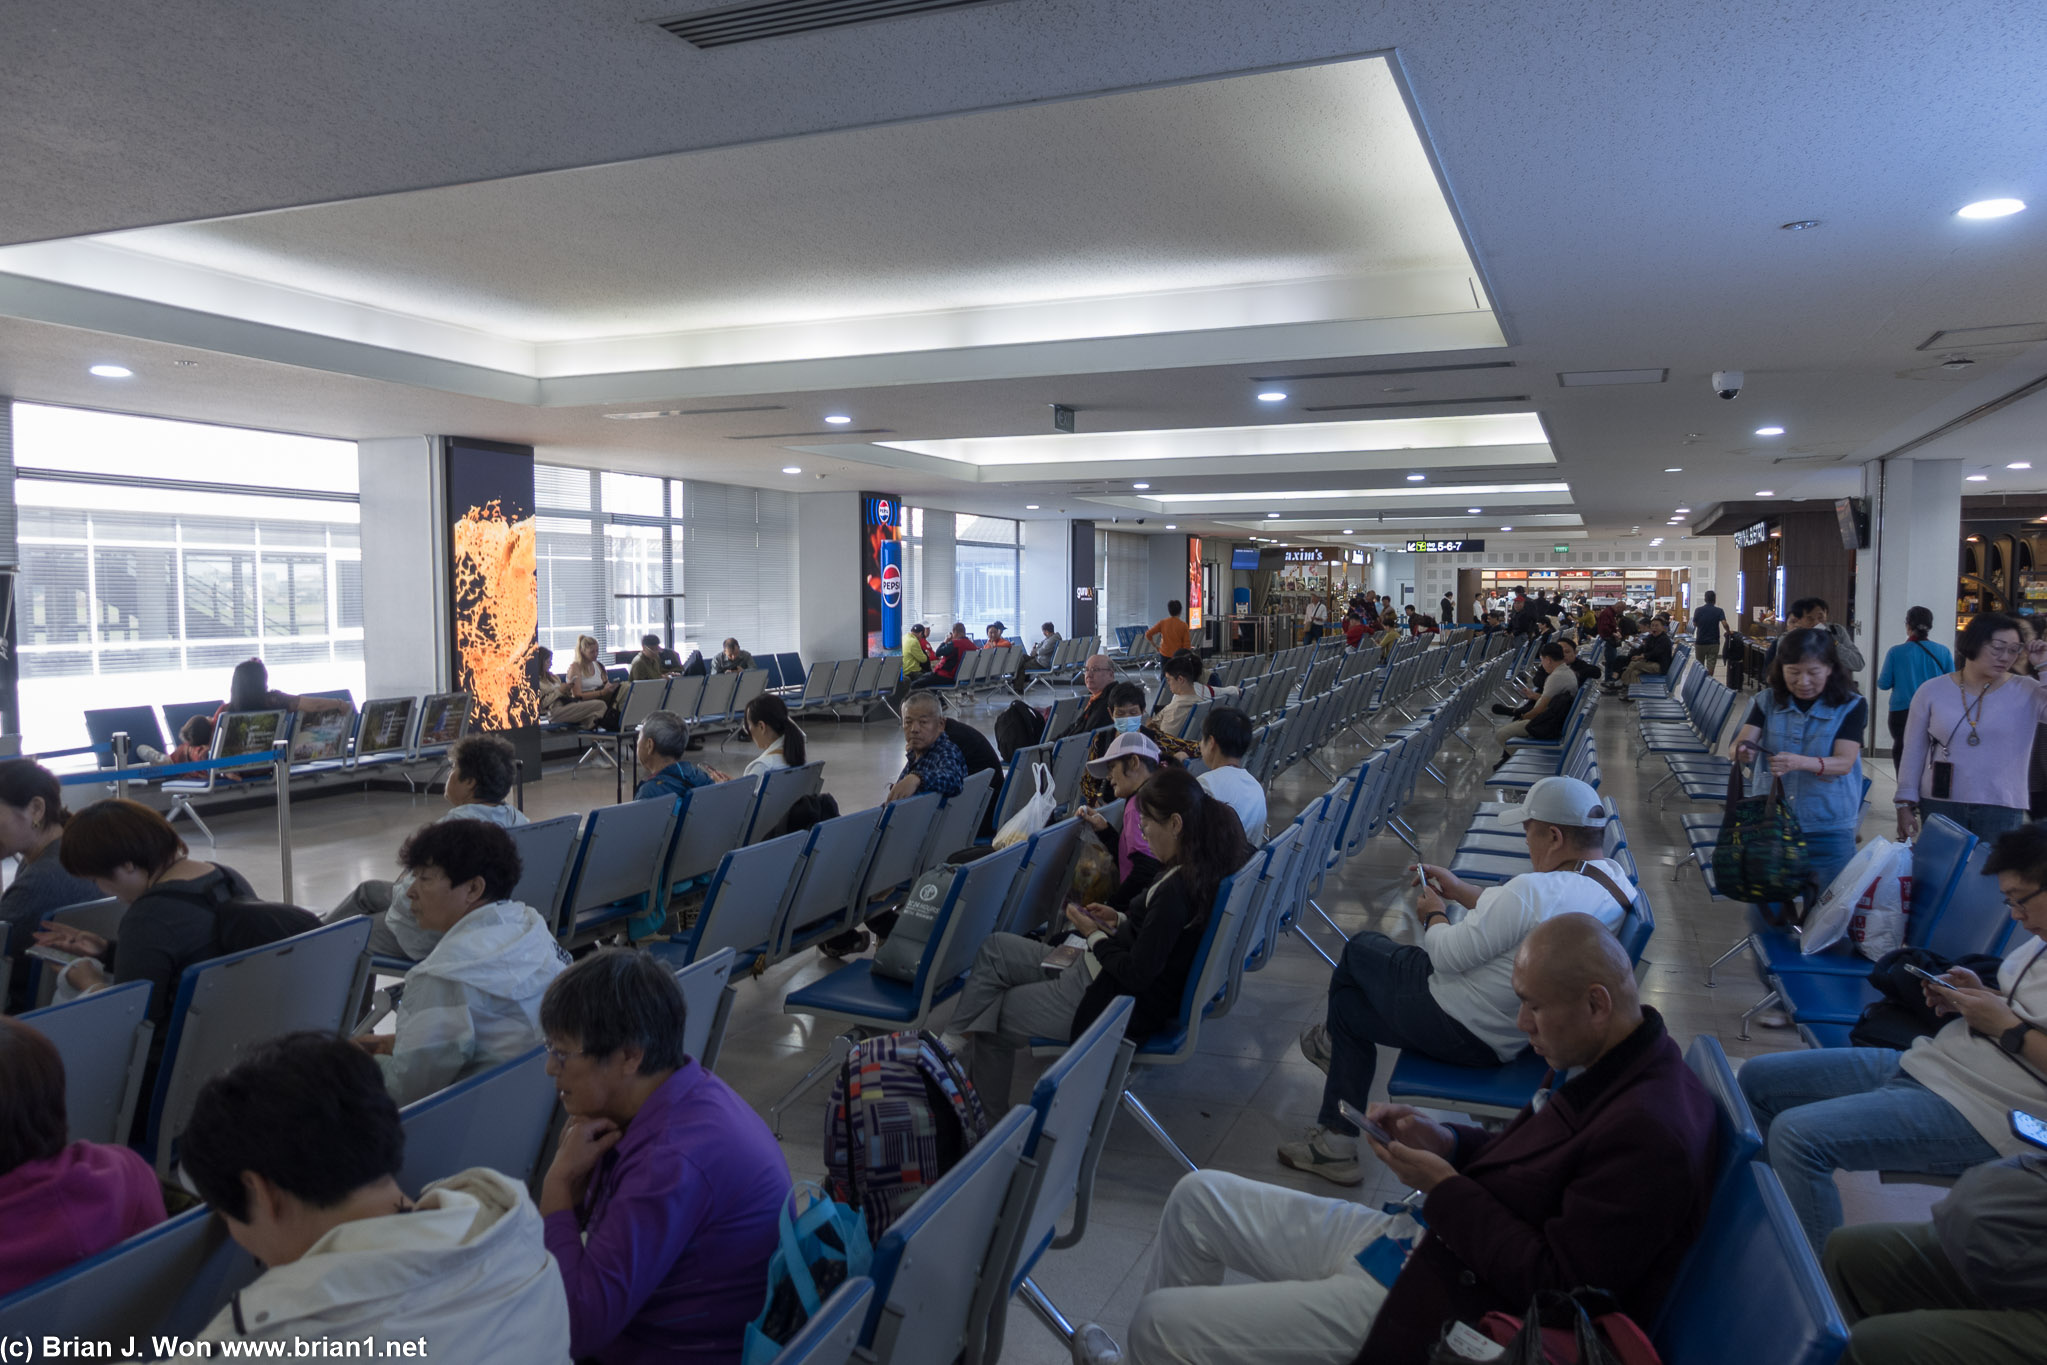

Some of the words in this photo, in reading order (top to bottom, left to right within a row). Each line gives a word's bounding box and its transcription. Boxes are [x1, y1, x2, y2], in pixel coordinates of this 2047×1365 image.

[1437, 541, 1462, 551] 5-6-7
[1285, 548, 1323, 561] axim's
[883, 581, 900, 590] PEPSI
